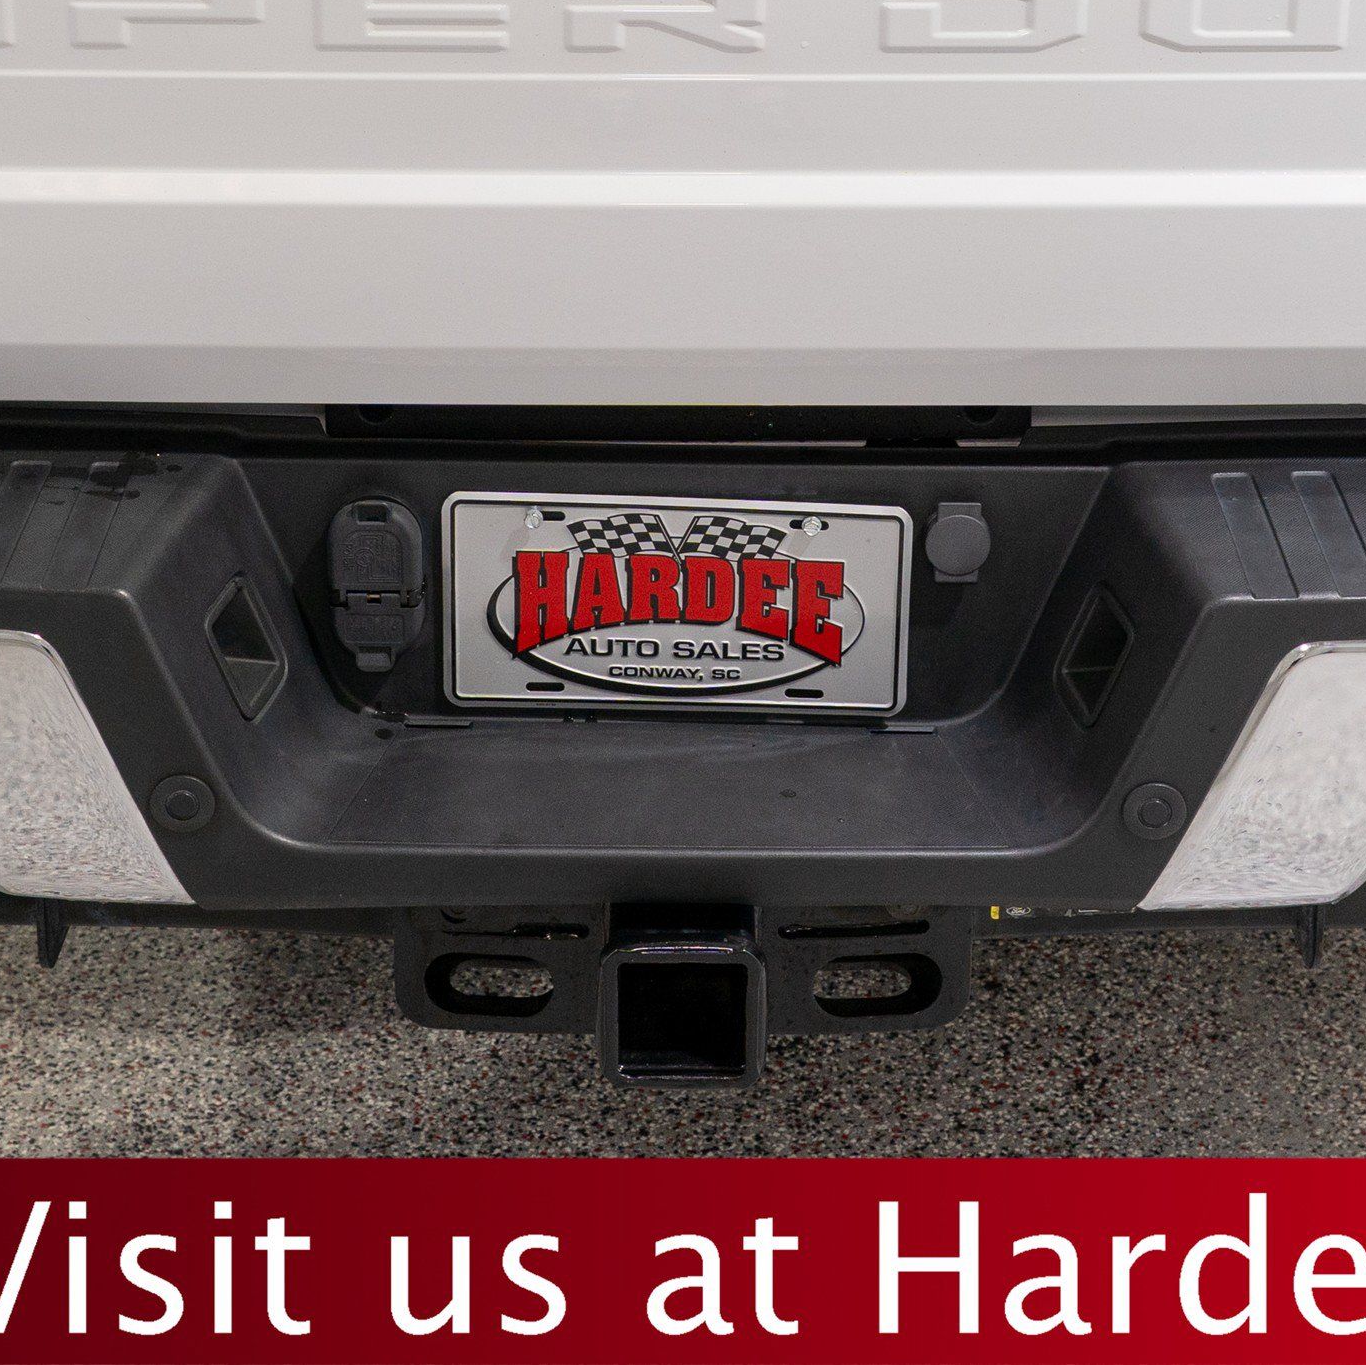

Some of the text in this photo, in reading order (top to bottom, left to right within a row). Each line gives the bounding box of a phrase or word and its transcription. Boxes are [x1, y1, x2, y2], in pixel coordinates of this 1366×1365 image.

[512, 549, 845, 667] HARDEE
[563, 637, 785, 662] AUTO SALES
[608, 665, 741, 681] CONWAY, SC
